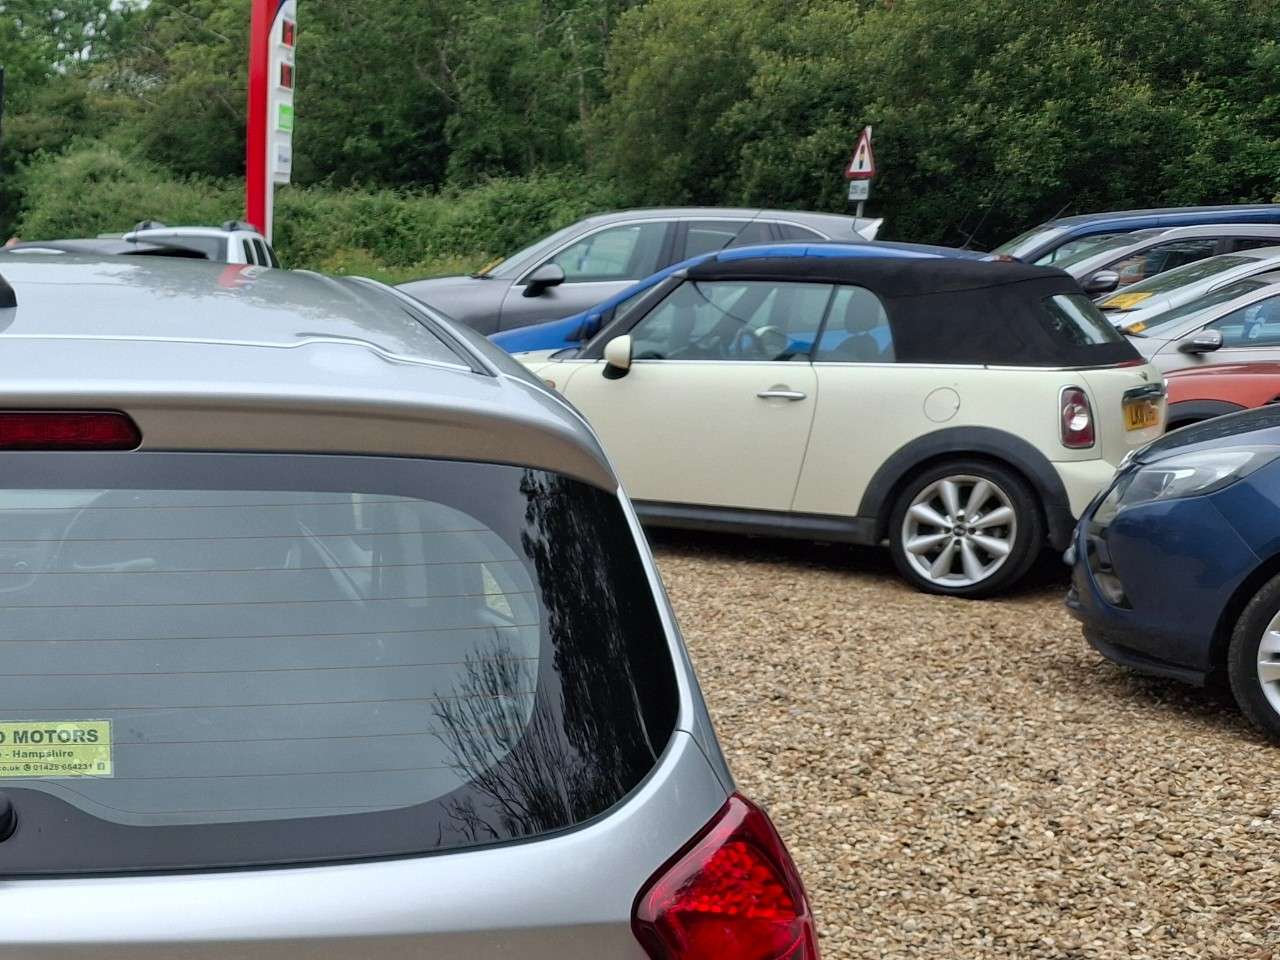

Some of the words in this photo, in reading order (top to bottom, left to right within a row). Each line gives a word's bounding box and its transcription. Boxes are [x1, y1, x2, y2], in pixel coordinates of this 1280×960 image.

[13, 728, 99, 744] MOTORS
[12, 749, 74, 760] Hampshire
[32, 764, 62, 772] 01425
